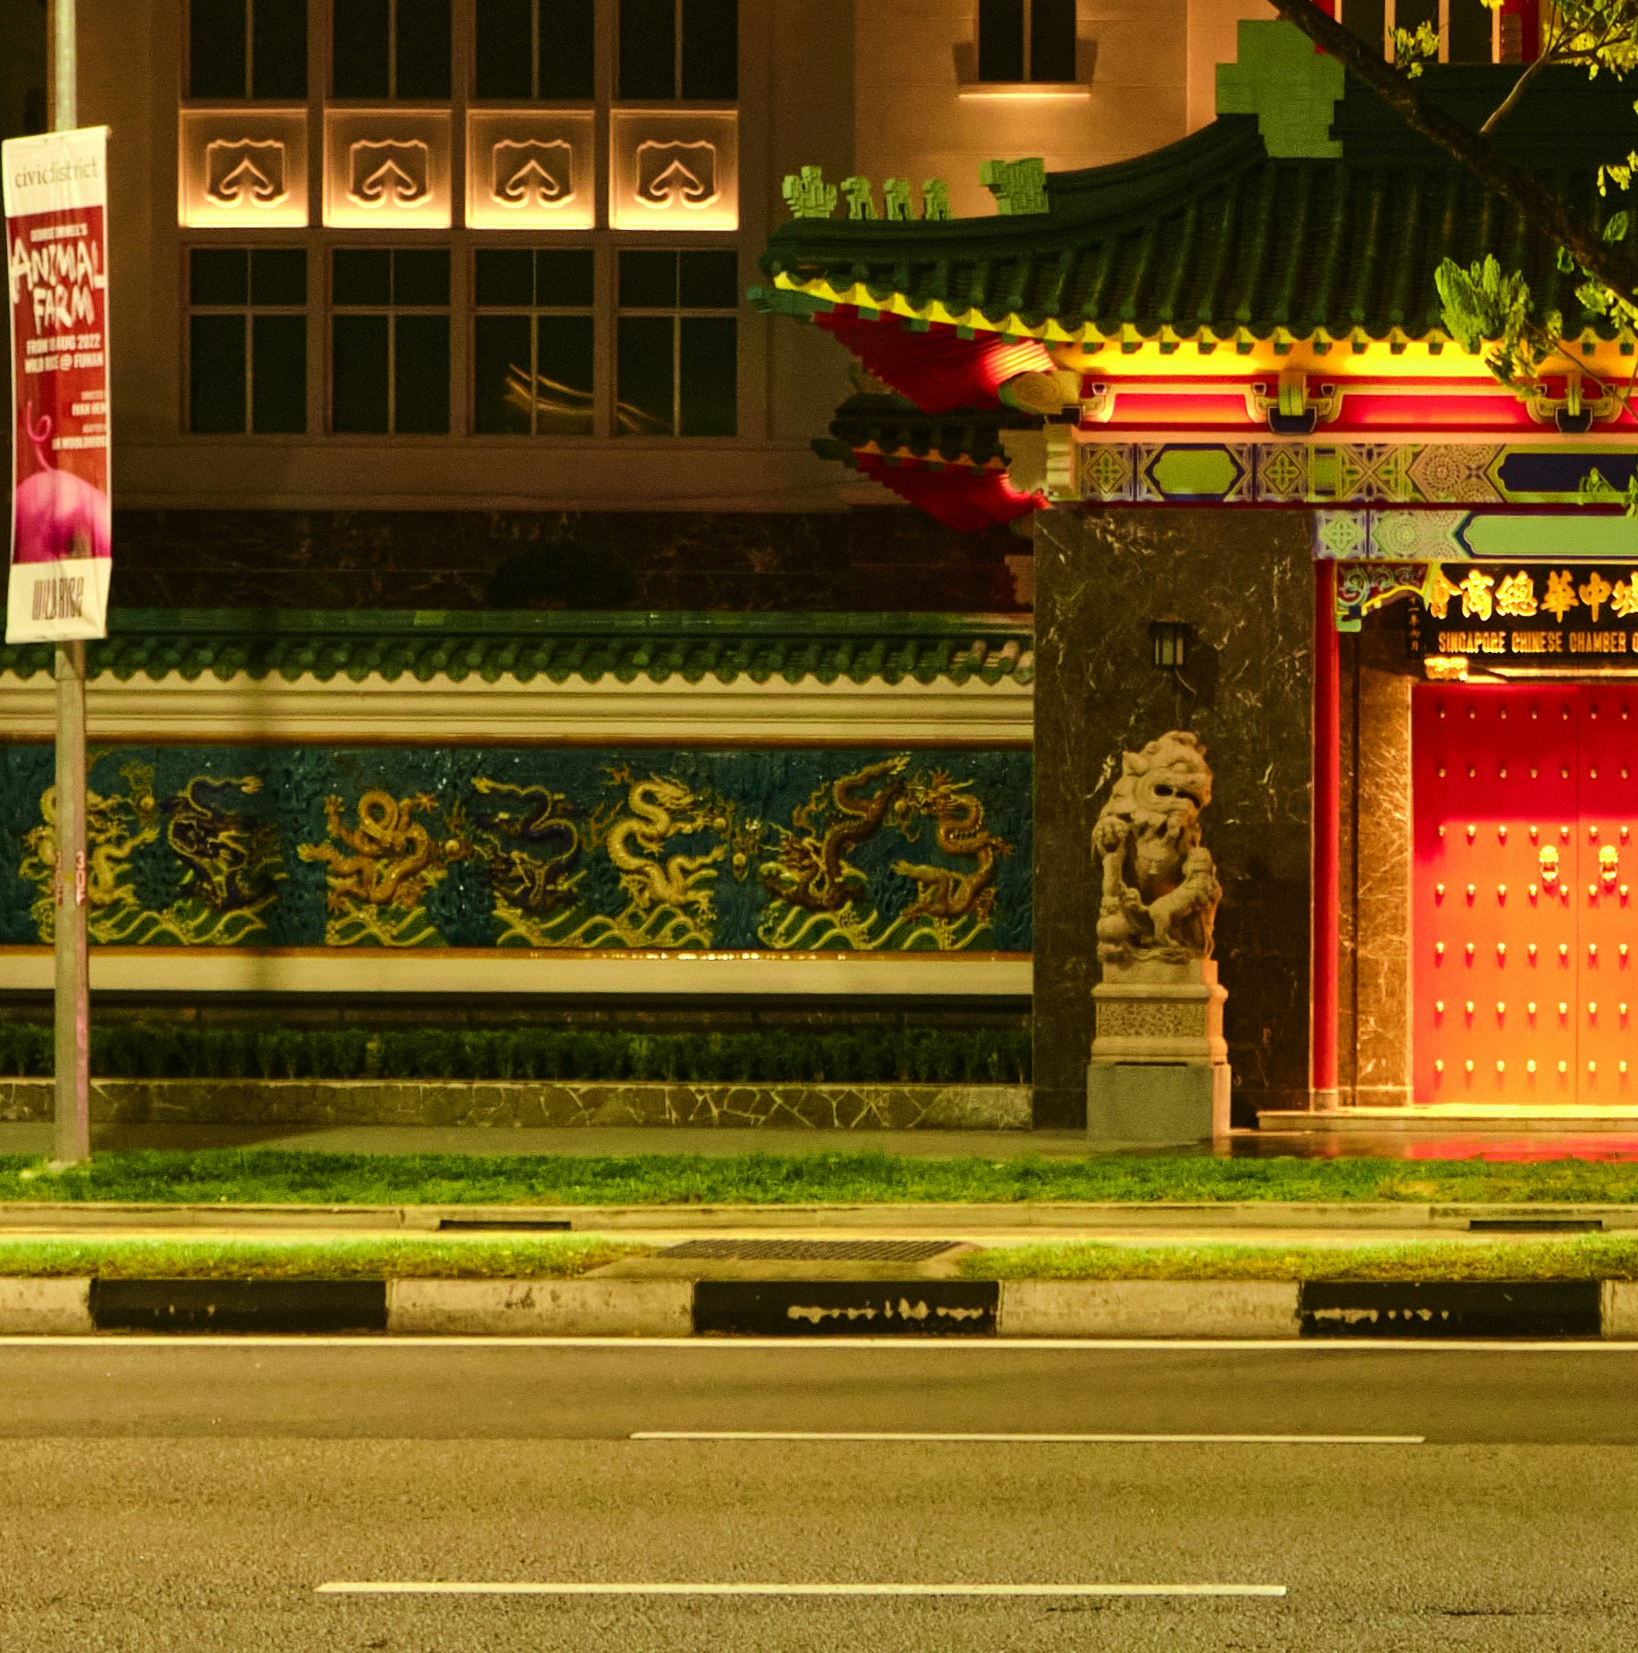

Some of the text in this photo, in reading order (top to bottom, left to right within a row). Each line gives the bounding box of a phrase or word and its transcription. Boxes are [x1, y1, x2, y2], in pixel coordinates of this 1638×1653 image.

[10, 237, 106, 304] ANIMAL
[33, 285, 95, 335] FARM
[1438, 631, 1506, 654] SINGAPORE
[1511, 631, 1563, 654] CHINESE
[1569, 631, 1627, 654] CHAMBER
